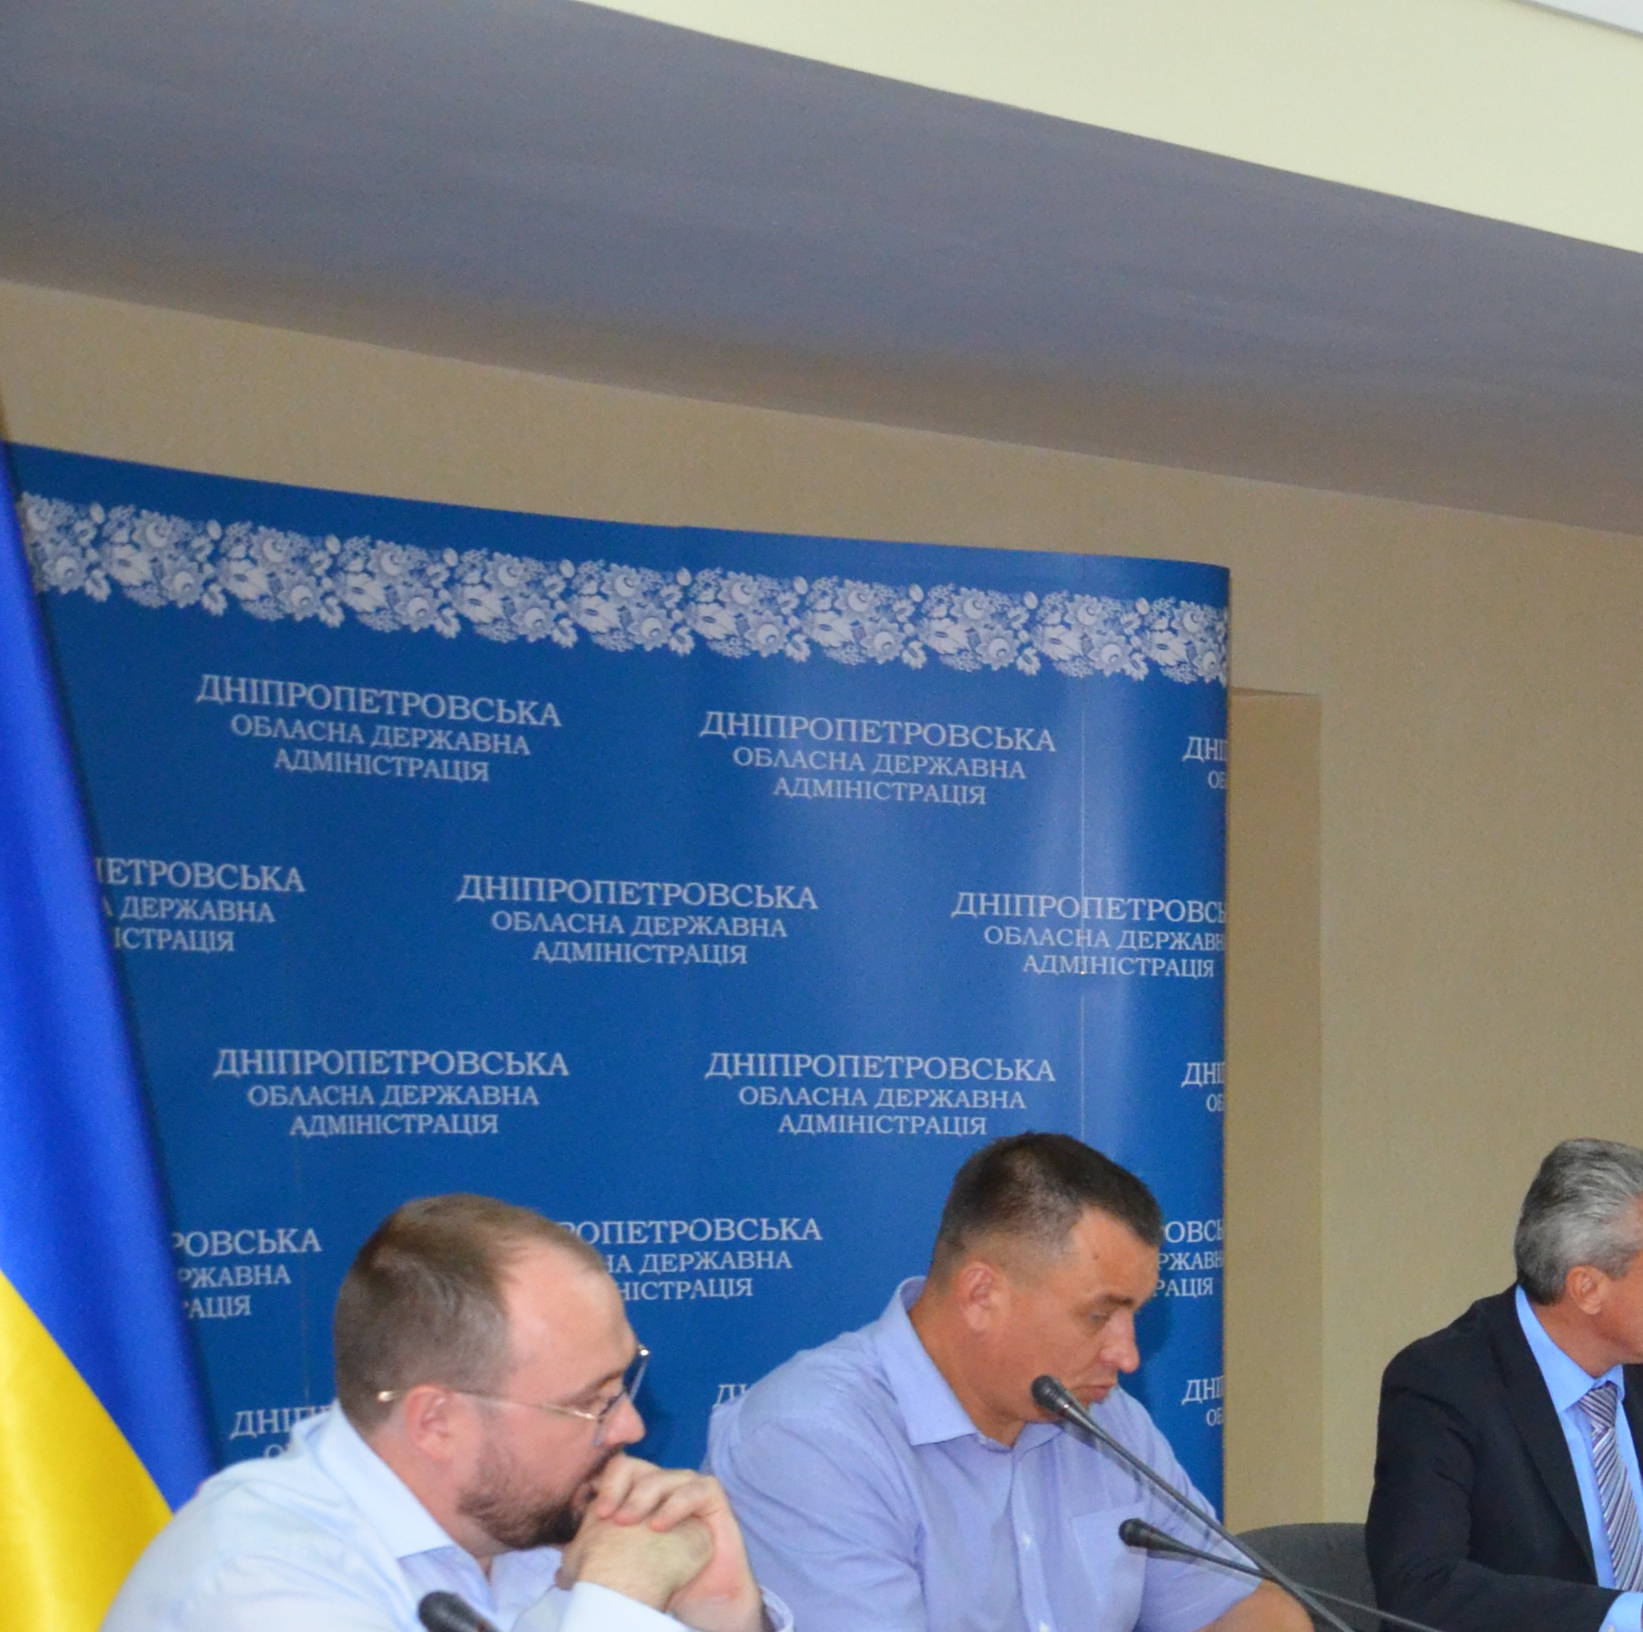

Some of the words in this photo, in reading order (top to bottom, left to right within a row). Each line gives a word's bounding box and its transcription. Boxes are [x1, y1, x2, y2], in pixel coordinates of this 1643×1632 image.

[196, 674, 562, 728] ДНІПРОПЕТРОВСЬКА
[231, 714, 364, 745] ОБЛАСНА
[371, 727, 530, 756] ДЕРЖАВНА
[699, 711, 1056, 752] ДНІПРОПЕТРОВСЬКА
[274, 749, 489, 782] АДМІНІСТРАЦІЯ
[733, 746, 865, 773] ОБЛАСНА
[873, 753, 1026, 780] ДЕРЖАВНА
[773, 777, 986, 805] АДМІНІСТРАЦІЯ
[456, 874, 818, 910] ДНІПРОПЕТРОВСЬКА
[119, 896, 276, 923] ДЕРЖАВНА
[491, 911, 625, 934] ОБЛАСНА
[631, 915, 788, 938] ДЕРЖАВНА
[984, 925, 1110, 949] ОБЛАСНА
[532, 941, 748, 965] АДМІНІСТРАЦІЯ
[1023, 954, 1214, 978] АДМІНІСТРАЦІЯ
[213, 1049, 570, 1078] ДНІПРОПЕТРОВСЬКА
[705, 1052, 1055, 1082] ДНІПРОПЕТРОВСЬКА
[247, 1085, 375, 1107] ОБЛАСНА
[381, 1084, 540, 1108] ДЕРЖАВНА
[739, 1085, 868, 1107] ОБЛАСНА
[874, 1088, 1026, 1110] ДЕРЖАВНА
[290, 1113, 499, 1138] АДМІНІСТРАЦІЯ
[778, 1114, 987, 1137] АДМІНІСТРАЦІЯ
[639, 1250, 793, 1275] ДЕРЖАВНА
